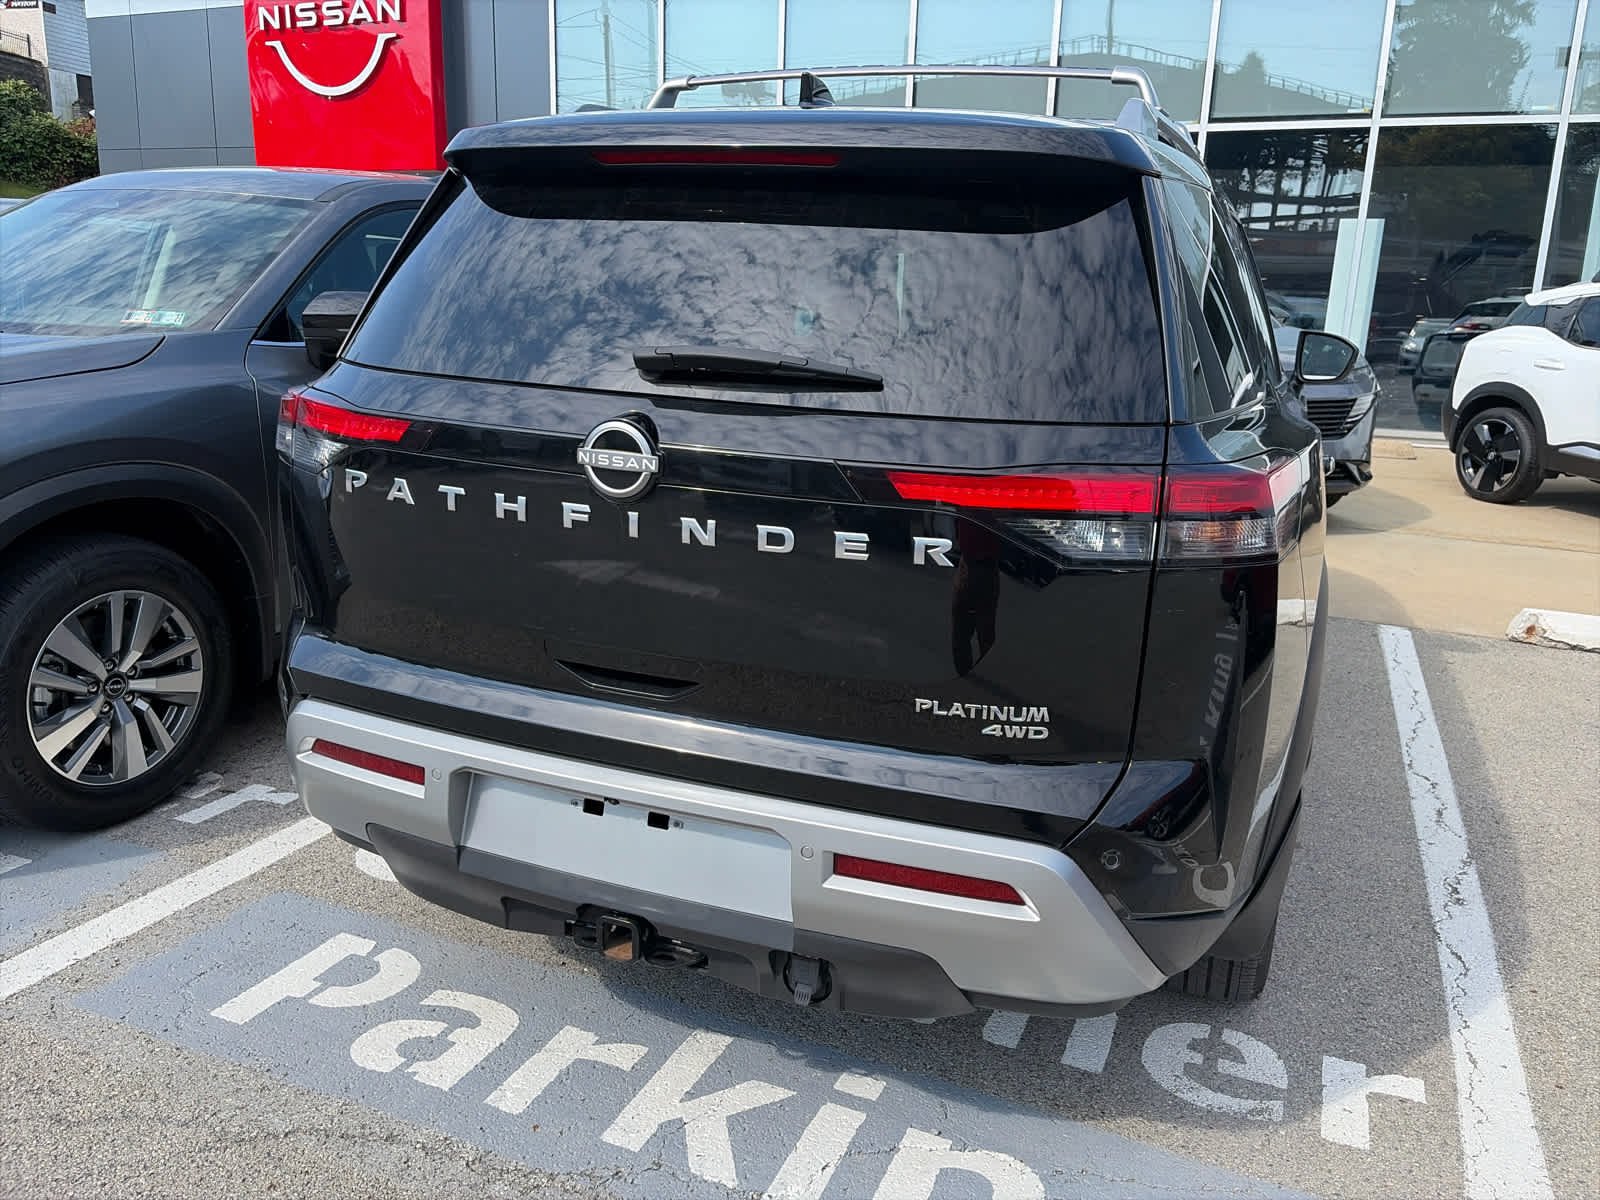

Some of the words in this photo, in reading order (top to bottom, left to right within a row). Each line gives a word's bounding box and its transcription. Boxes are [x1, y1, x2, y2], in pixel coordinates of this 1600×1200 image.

[258, 0, 401, 31] NISSAN
[578, 451, 656, 471] NISSAN
[344, 469, 955, 568] PATHFINDER
[914, 698, 1051, 723] PLATINUM
[981, 724, 1050, 740] 4WD
